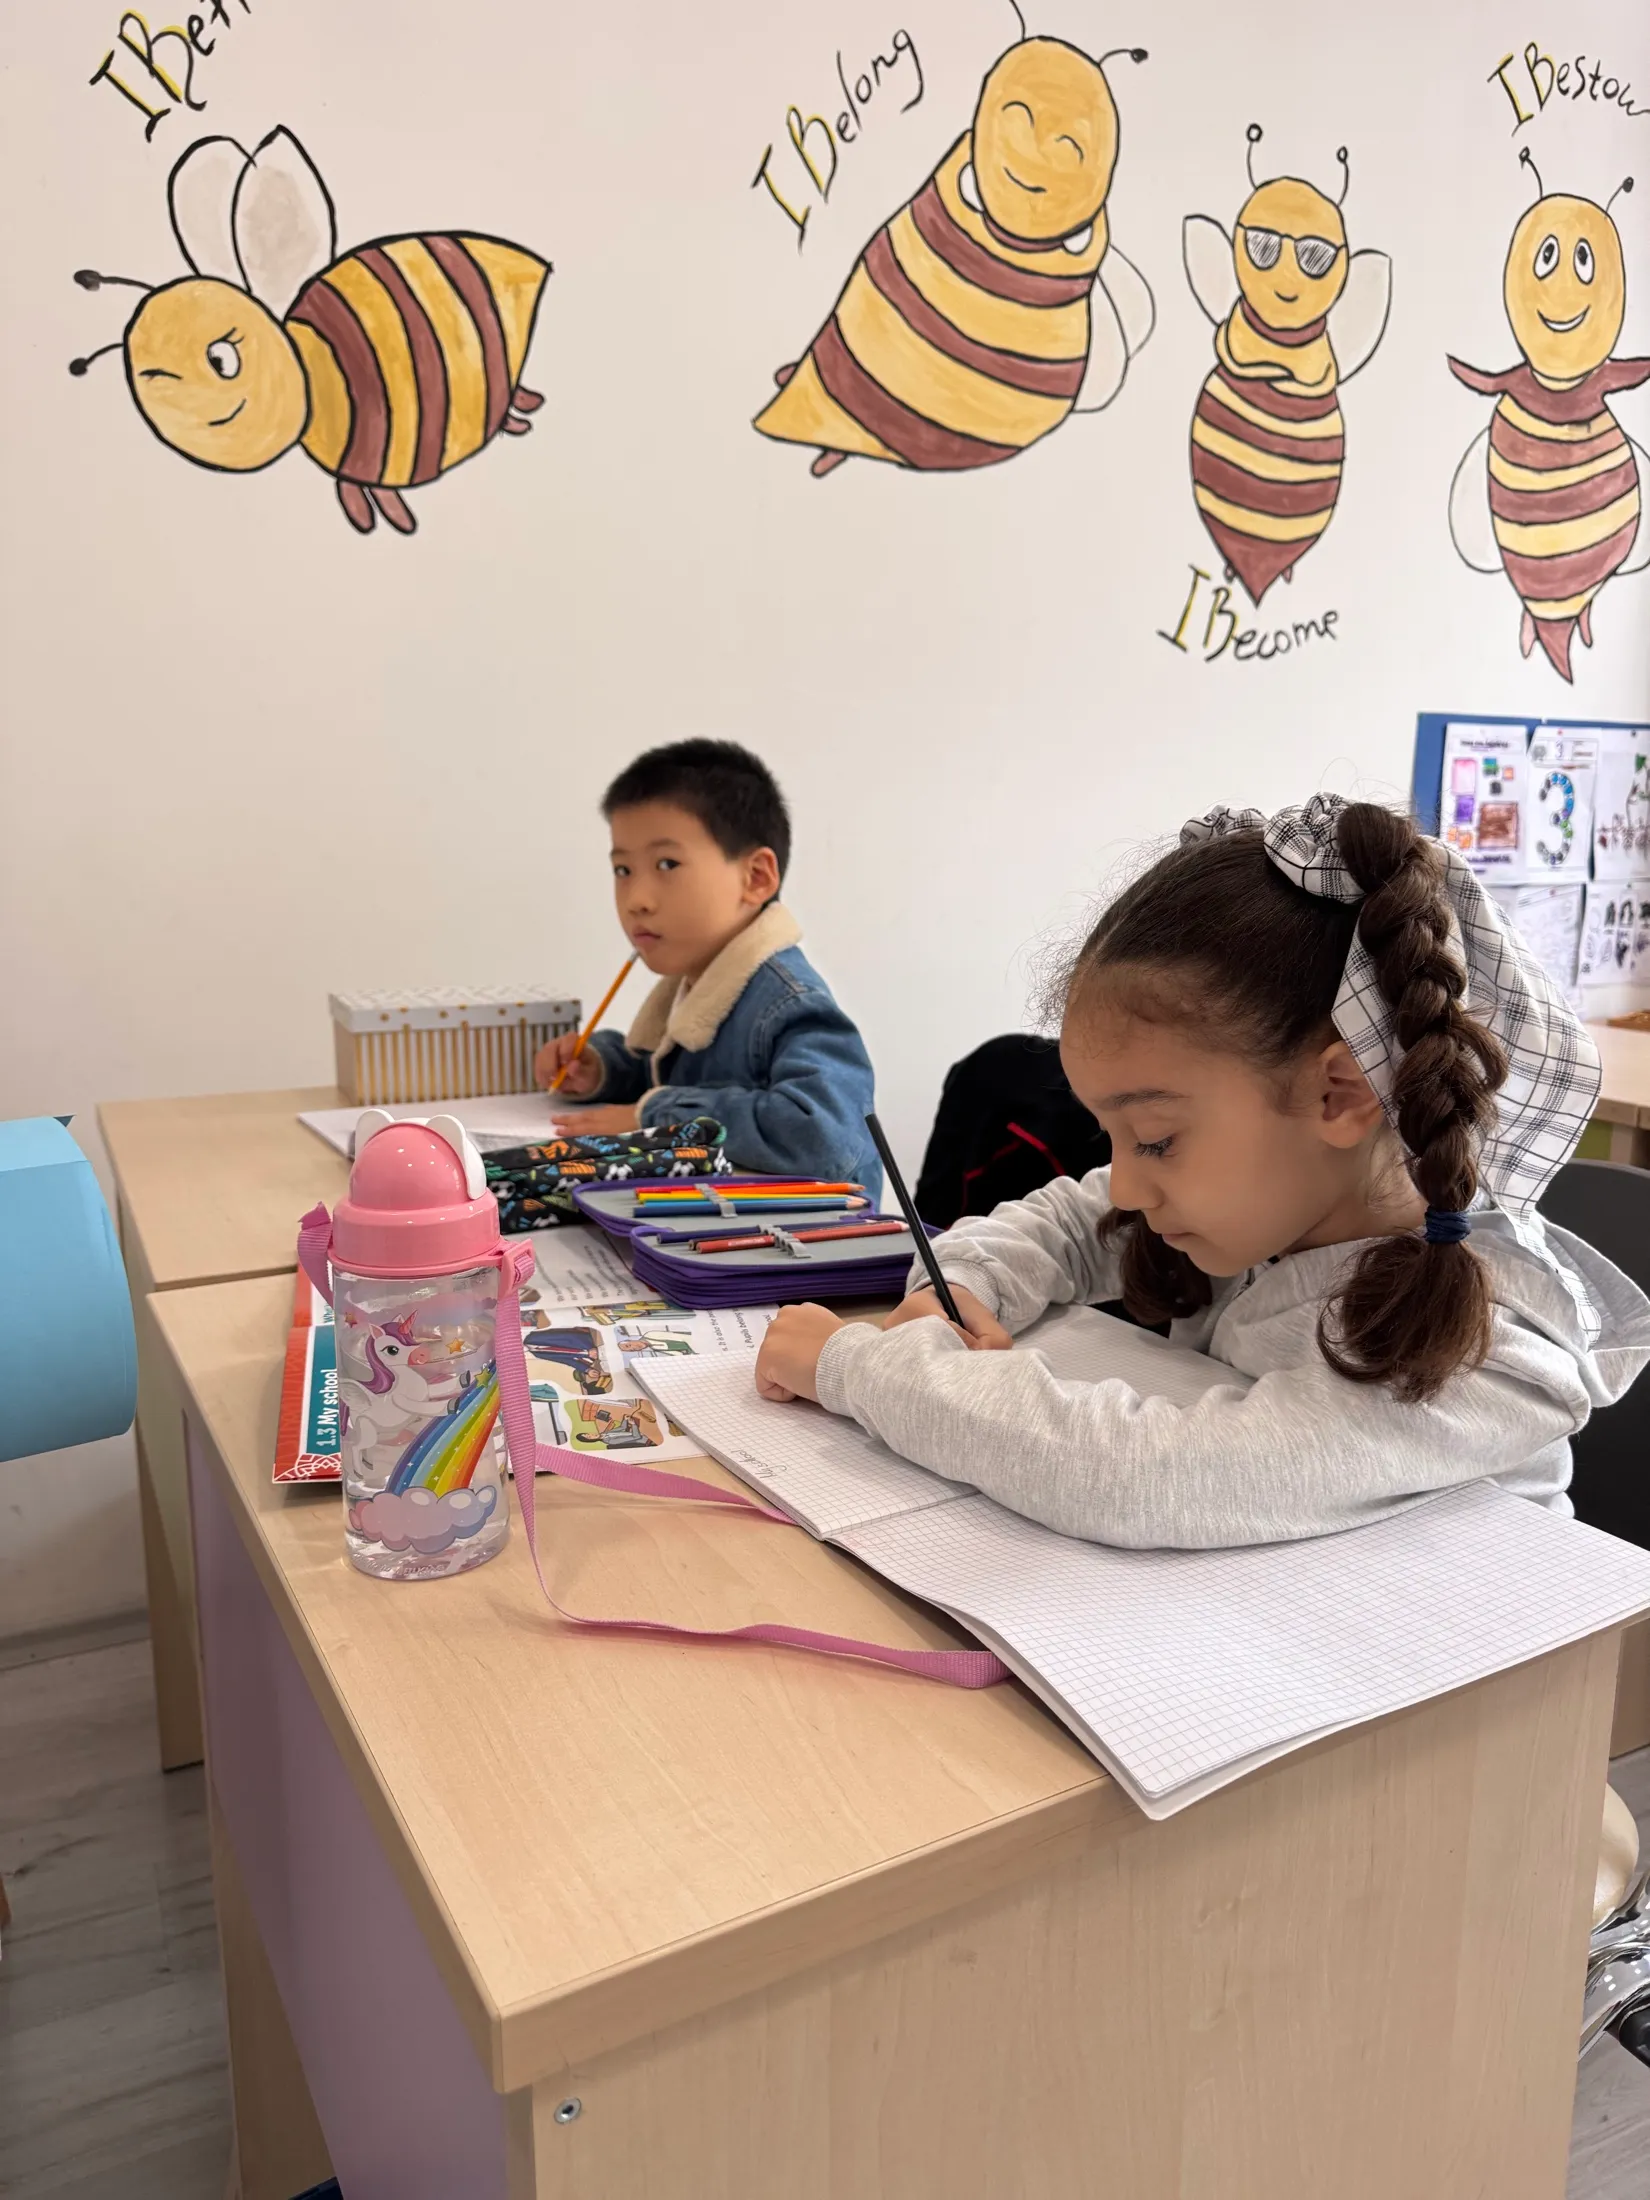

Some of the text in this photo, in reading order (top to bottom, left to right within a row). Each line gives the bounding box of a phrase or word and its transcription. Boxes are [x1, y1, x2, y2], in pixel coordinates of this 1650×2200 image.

[786, 28, 925, 204] Belong
[1203, 586, 1339, 664] Become
[734, 1312, 748, 1328] belong
[740, 1328, 753, 1344] Pupils
[316, 1368, 339, 1447] 1.3 My school
